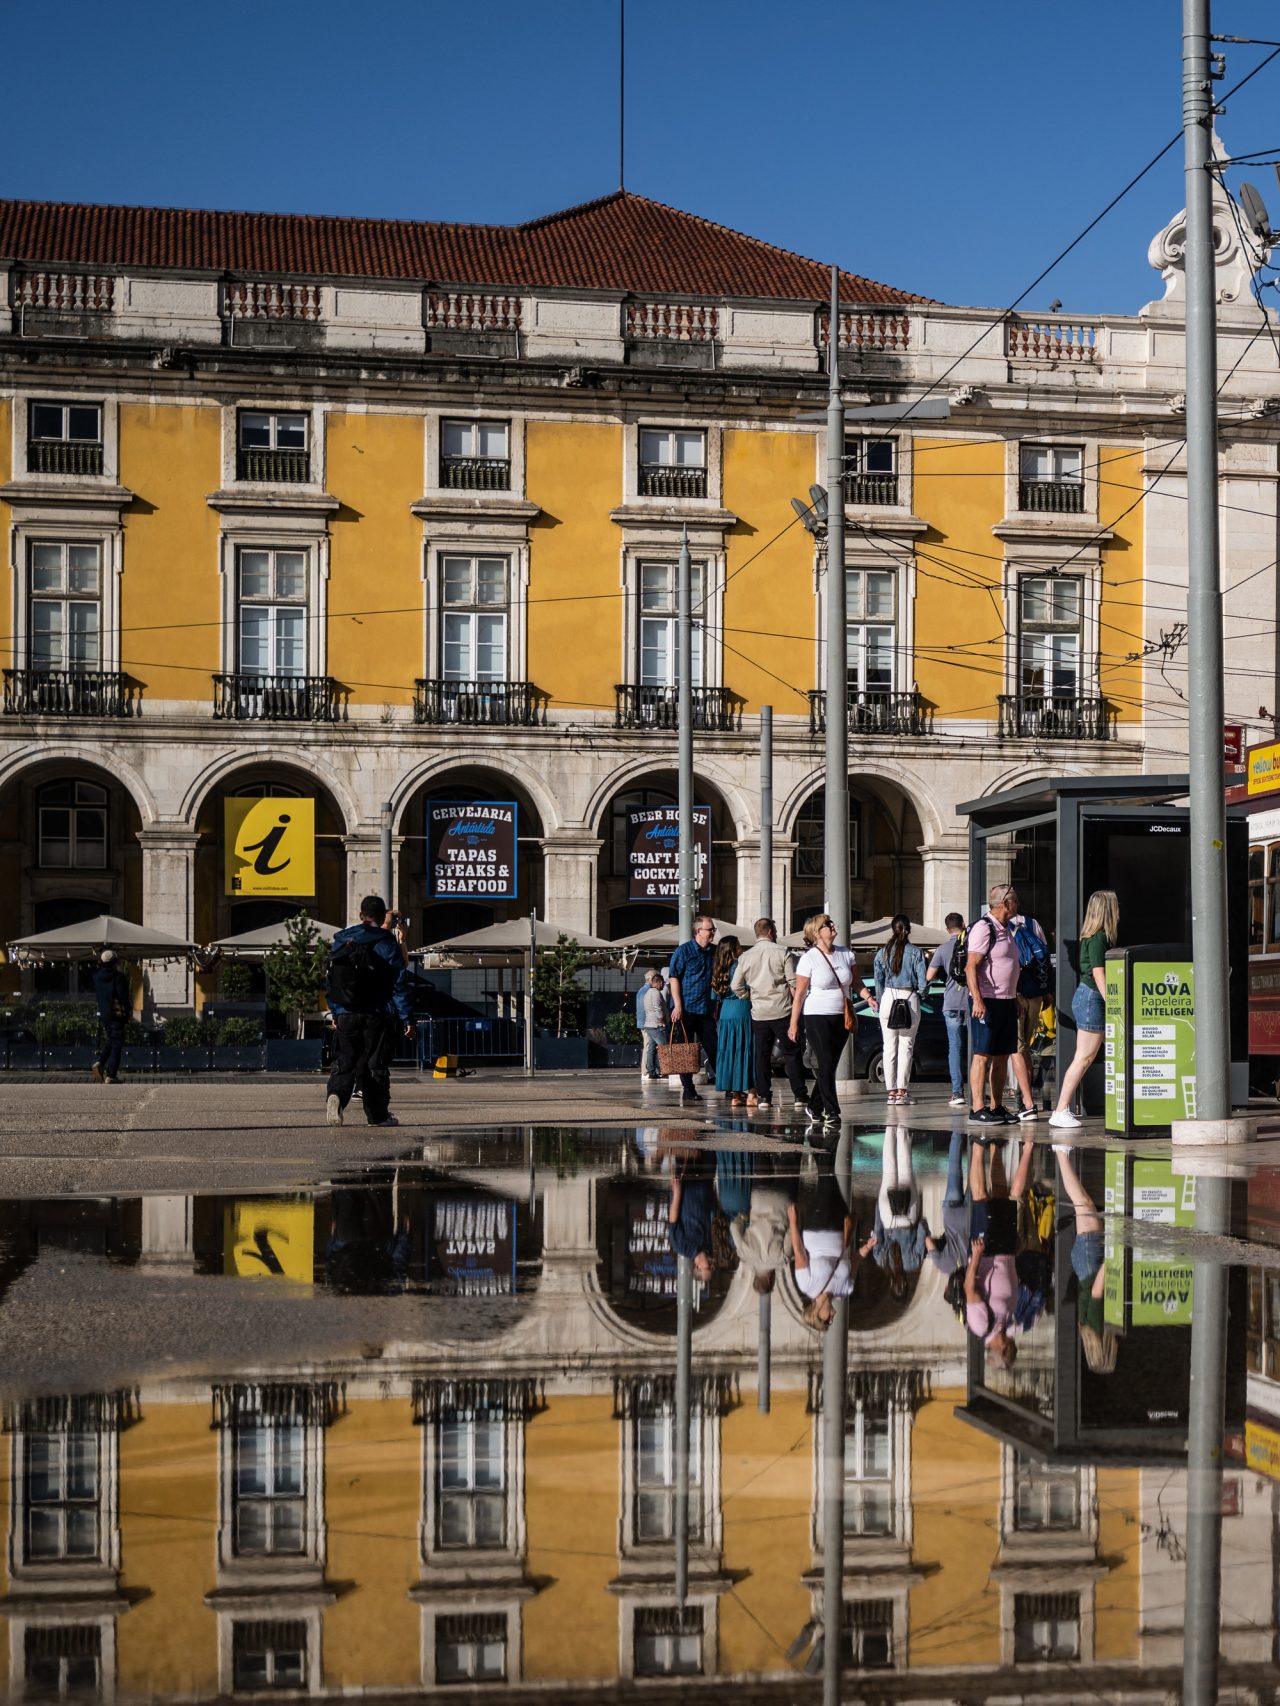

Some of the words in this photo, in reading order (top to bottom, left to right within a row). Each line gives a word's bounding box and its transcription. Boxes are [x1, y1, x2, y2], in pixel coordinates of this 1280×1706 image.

[432, 806, 512, 822] CERVEJARIA
[630, 810, 663, 824] BEER
[666, 810, 707, 825] HOSE
[645, 824, 681, 839] Antárt
[1149, 825, 1182, 833] JCDecaux
[243, 814, 291, 875] i
[447, 849, 497, 862] TAPAS
[630, 852, 672, 864] CRAFT
[435, 864, 496, 877] STEAKS
[498, 864, 510, 877] &
[437, 880, 507, 892] SEAFOOD
[646, 883, 656, 895] &
[1141, 982, 1191, 996] NOVA
[1141, 996, 1192, 1006] Papeleira
[1142, 1007, 1194, 1016] INTELIGEN
